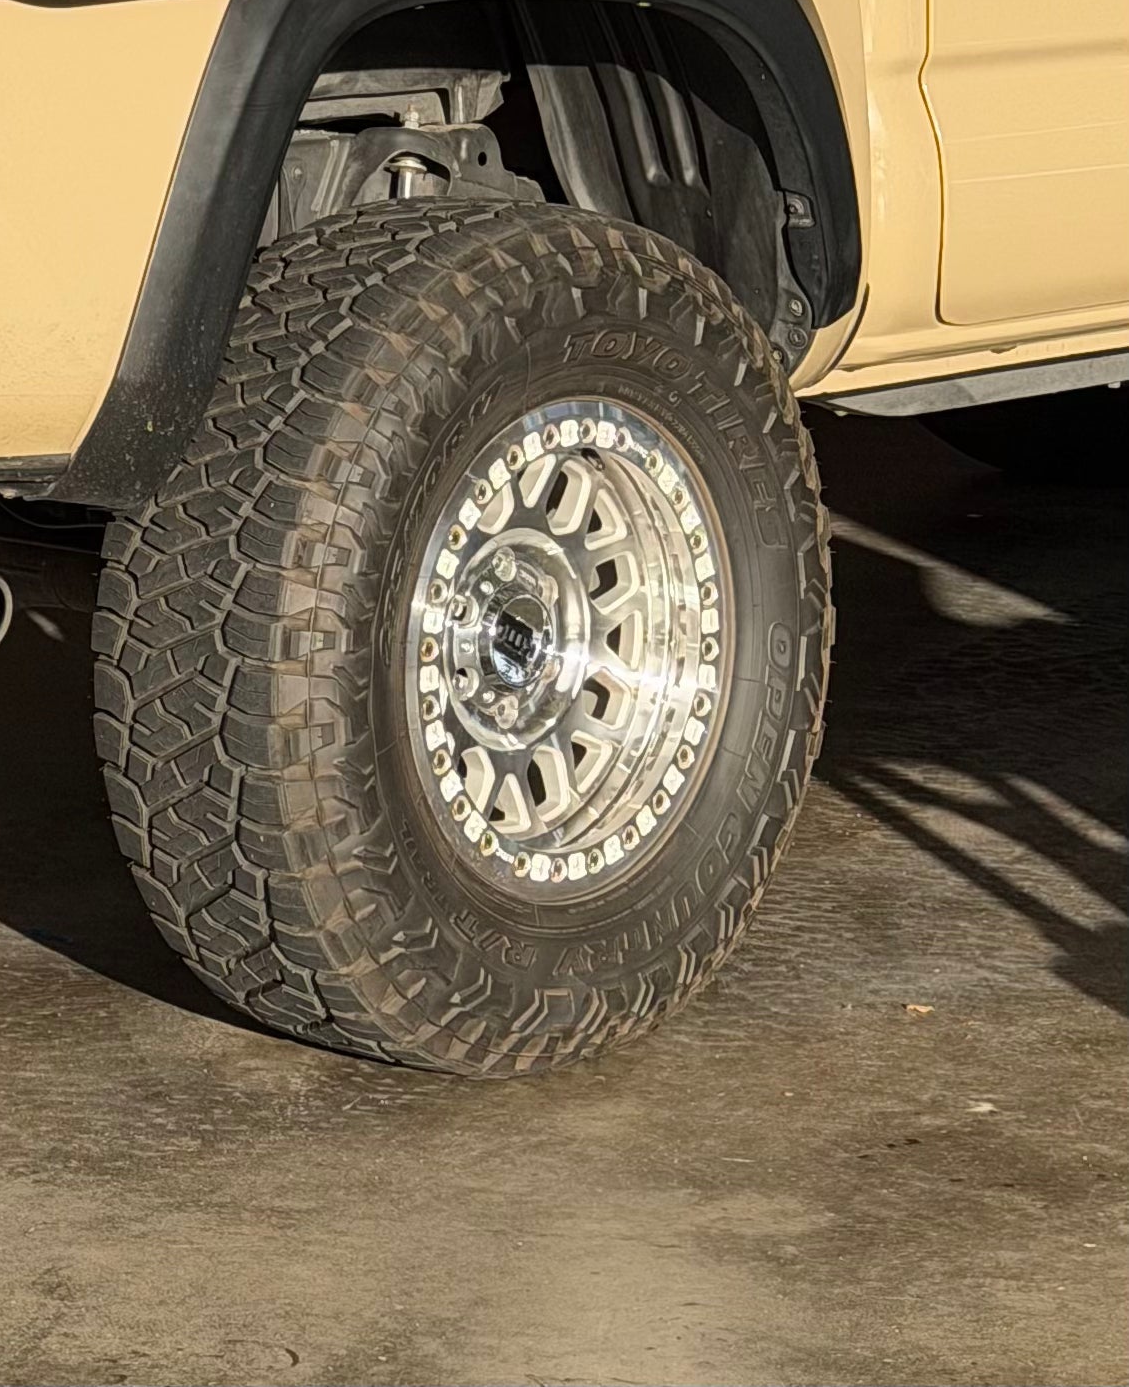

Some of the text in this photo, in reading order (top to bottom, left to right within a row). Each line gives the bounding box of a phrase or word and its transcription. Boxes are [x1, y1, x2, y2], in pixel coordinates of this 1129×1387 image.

[563, 329, 694, 381] TOYO
[686, 371, 791, 549] TIRES
[736, 621, 794, 814] OPEN
[450, 910, 537, 969] R/T
[553, 813, 742, 977] COUNTRY
